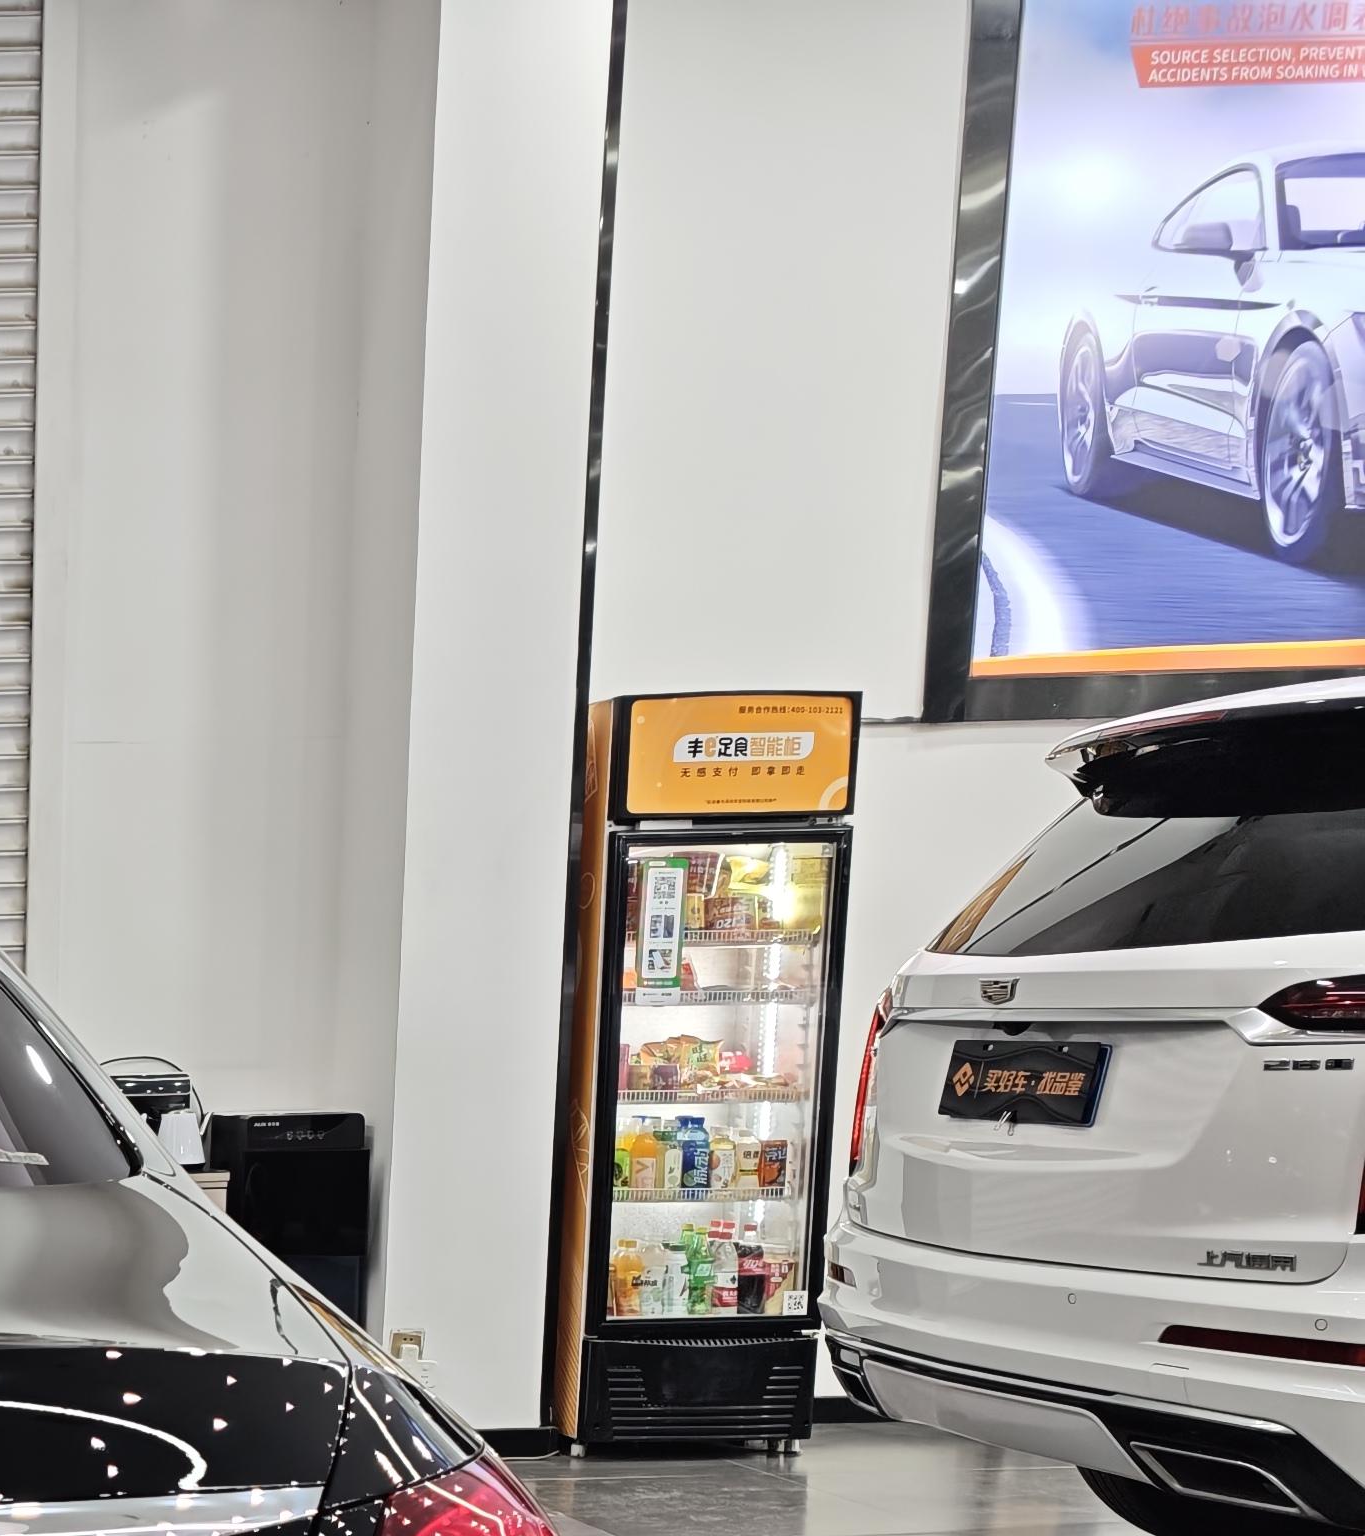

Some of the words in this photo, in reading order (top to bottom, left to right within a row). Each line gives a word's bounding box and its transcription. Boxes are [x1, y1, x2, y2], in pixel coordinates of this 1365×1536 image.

[1150, 49, 1208, 65] SOURCE
[1212, 47, 1296, 64] SELECTION,
[1147, 66, 1228, 82] ACCIDENTS
[1231, 66, 1272, 81] FROM
[1276, 64, 1340, 79] SOAKING
[1343, 63, 1359, 77] IN
[687, 736, 802, 758] 丰e足食智能柜
[680, 767, 739, 778] 无感支付
